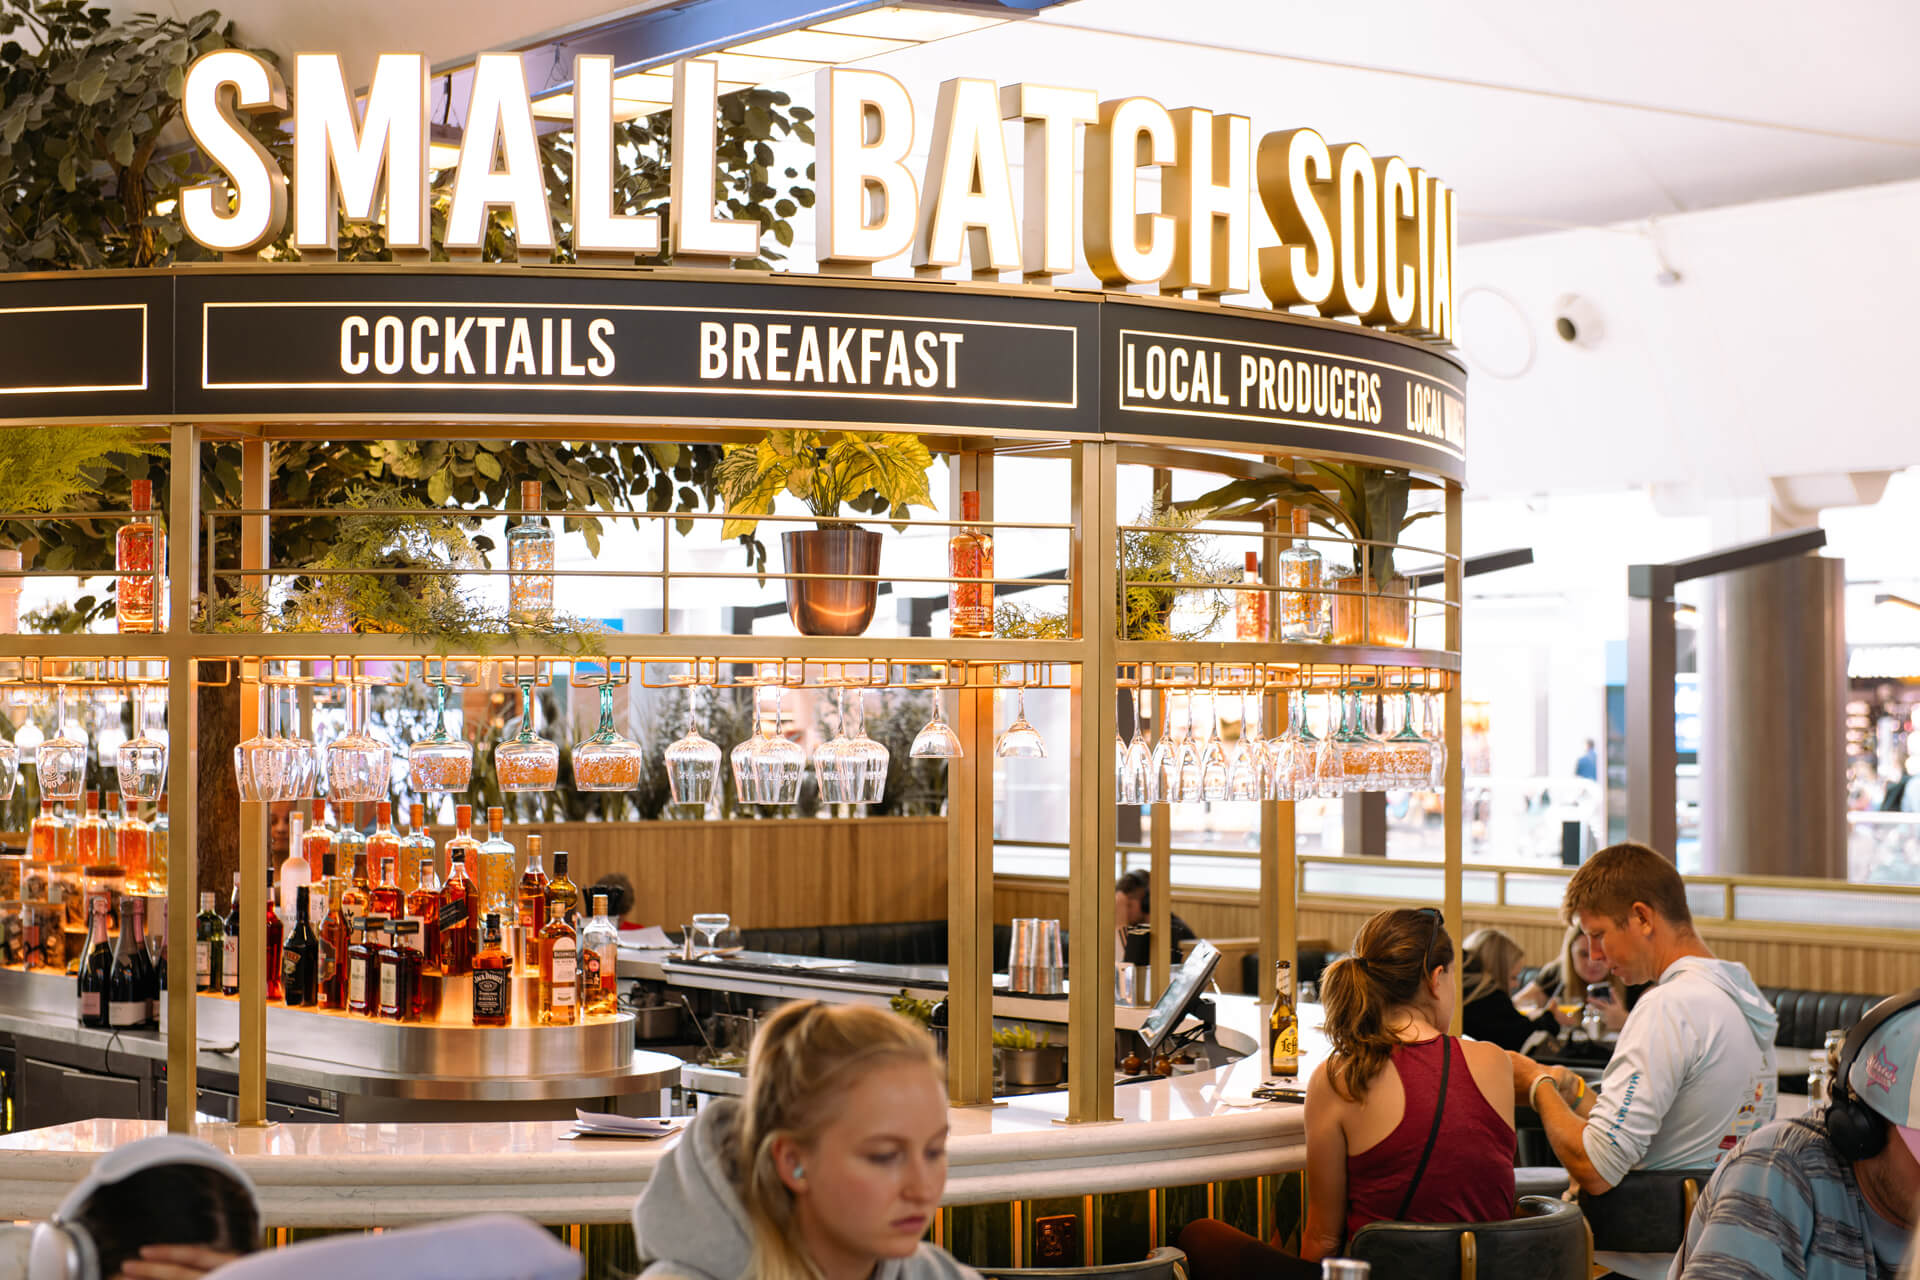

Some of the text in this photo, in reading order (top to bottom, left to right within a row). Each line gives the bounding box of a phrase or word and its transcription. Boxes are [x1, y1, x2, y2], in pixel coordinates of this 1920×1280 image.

[182, 49, 1460, 350] SMALL BATCH SOCIAL
[339, 315, 966, 390] COCKTAILS BREAKFAST
[1126, 342, 1231, 406] LOCAL
[1240, 353, 1383, 425] PRODUCERS
[1406, 380, 1445, 440] LOCAL
